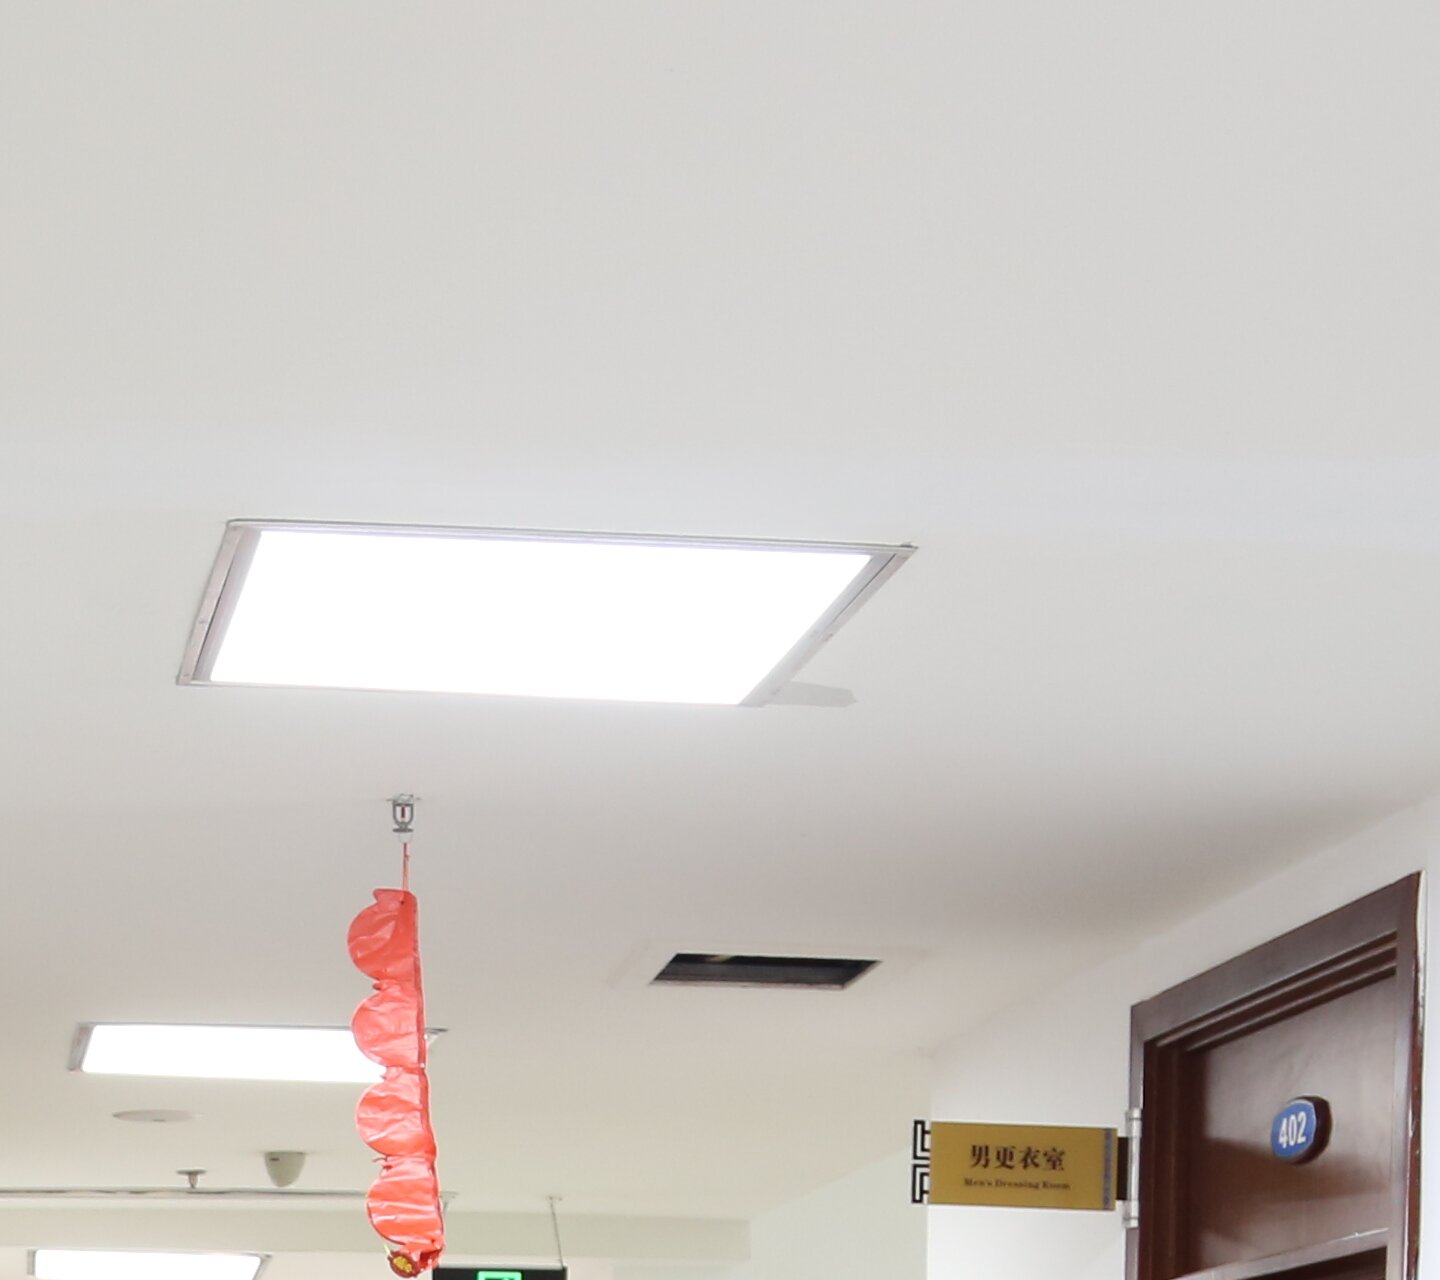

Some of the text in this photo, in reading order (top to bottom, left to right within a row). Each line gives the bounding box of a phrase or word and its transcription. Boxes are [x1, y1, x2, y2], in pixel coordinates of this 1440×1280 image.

[1278, 1111, 1307, 1149] 402
[970, 1145, 1065, 1171] 男更衣室
[964, 1177, 1070, 1191] Men's Dressing Room
